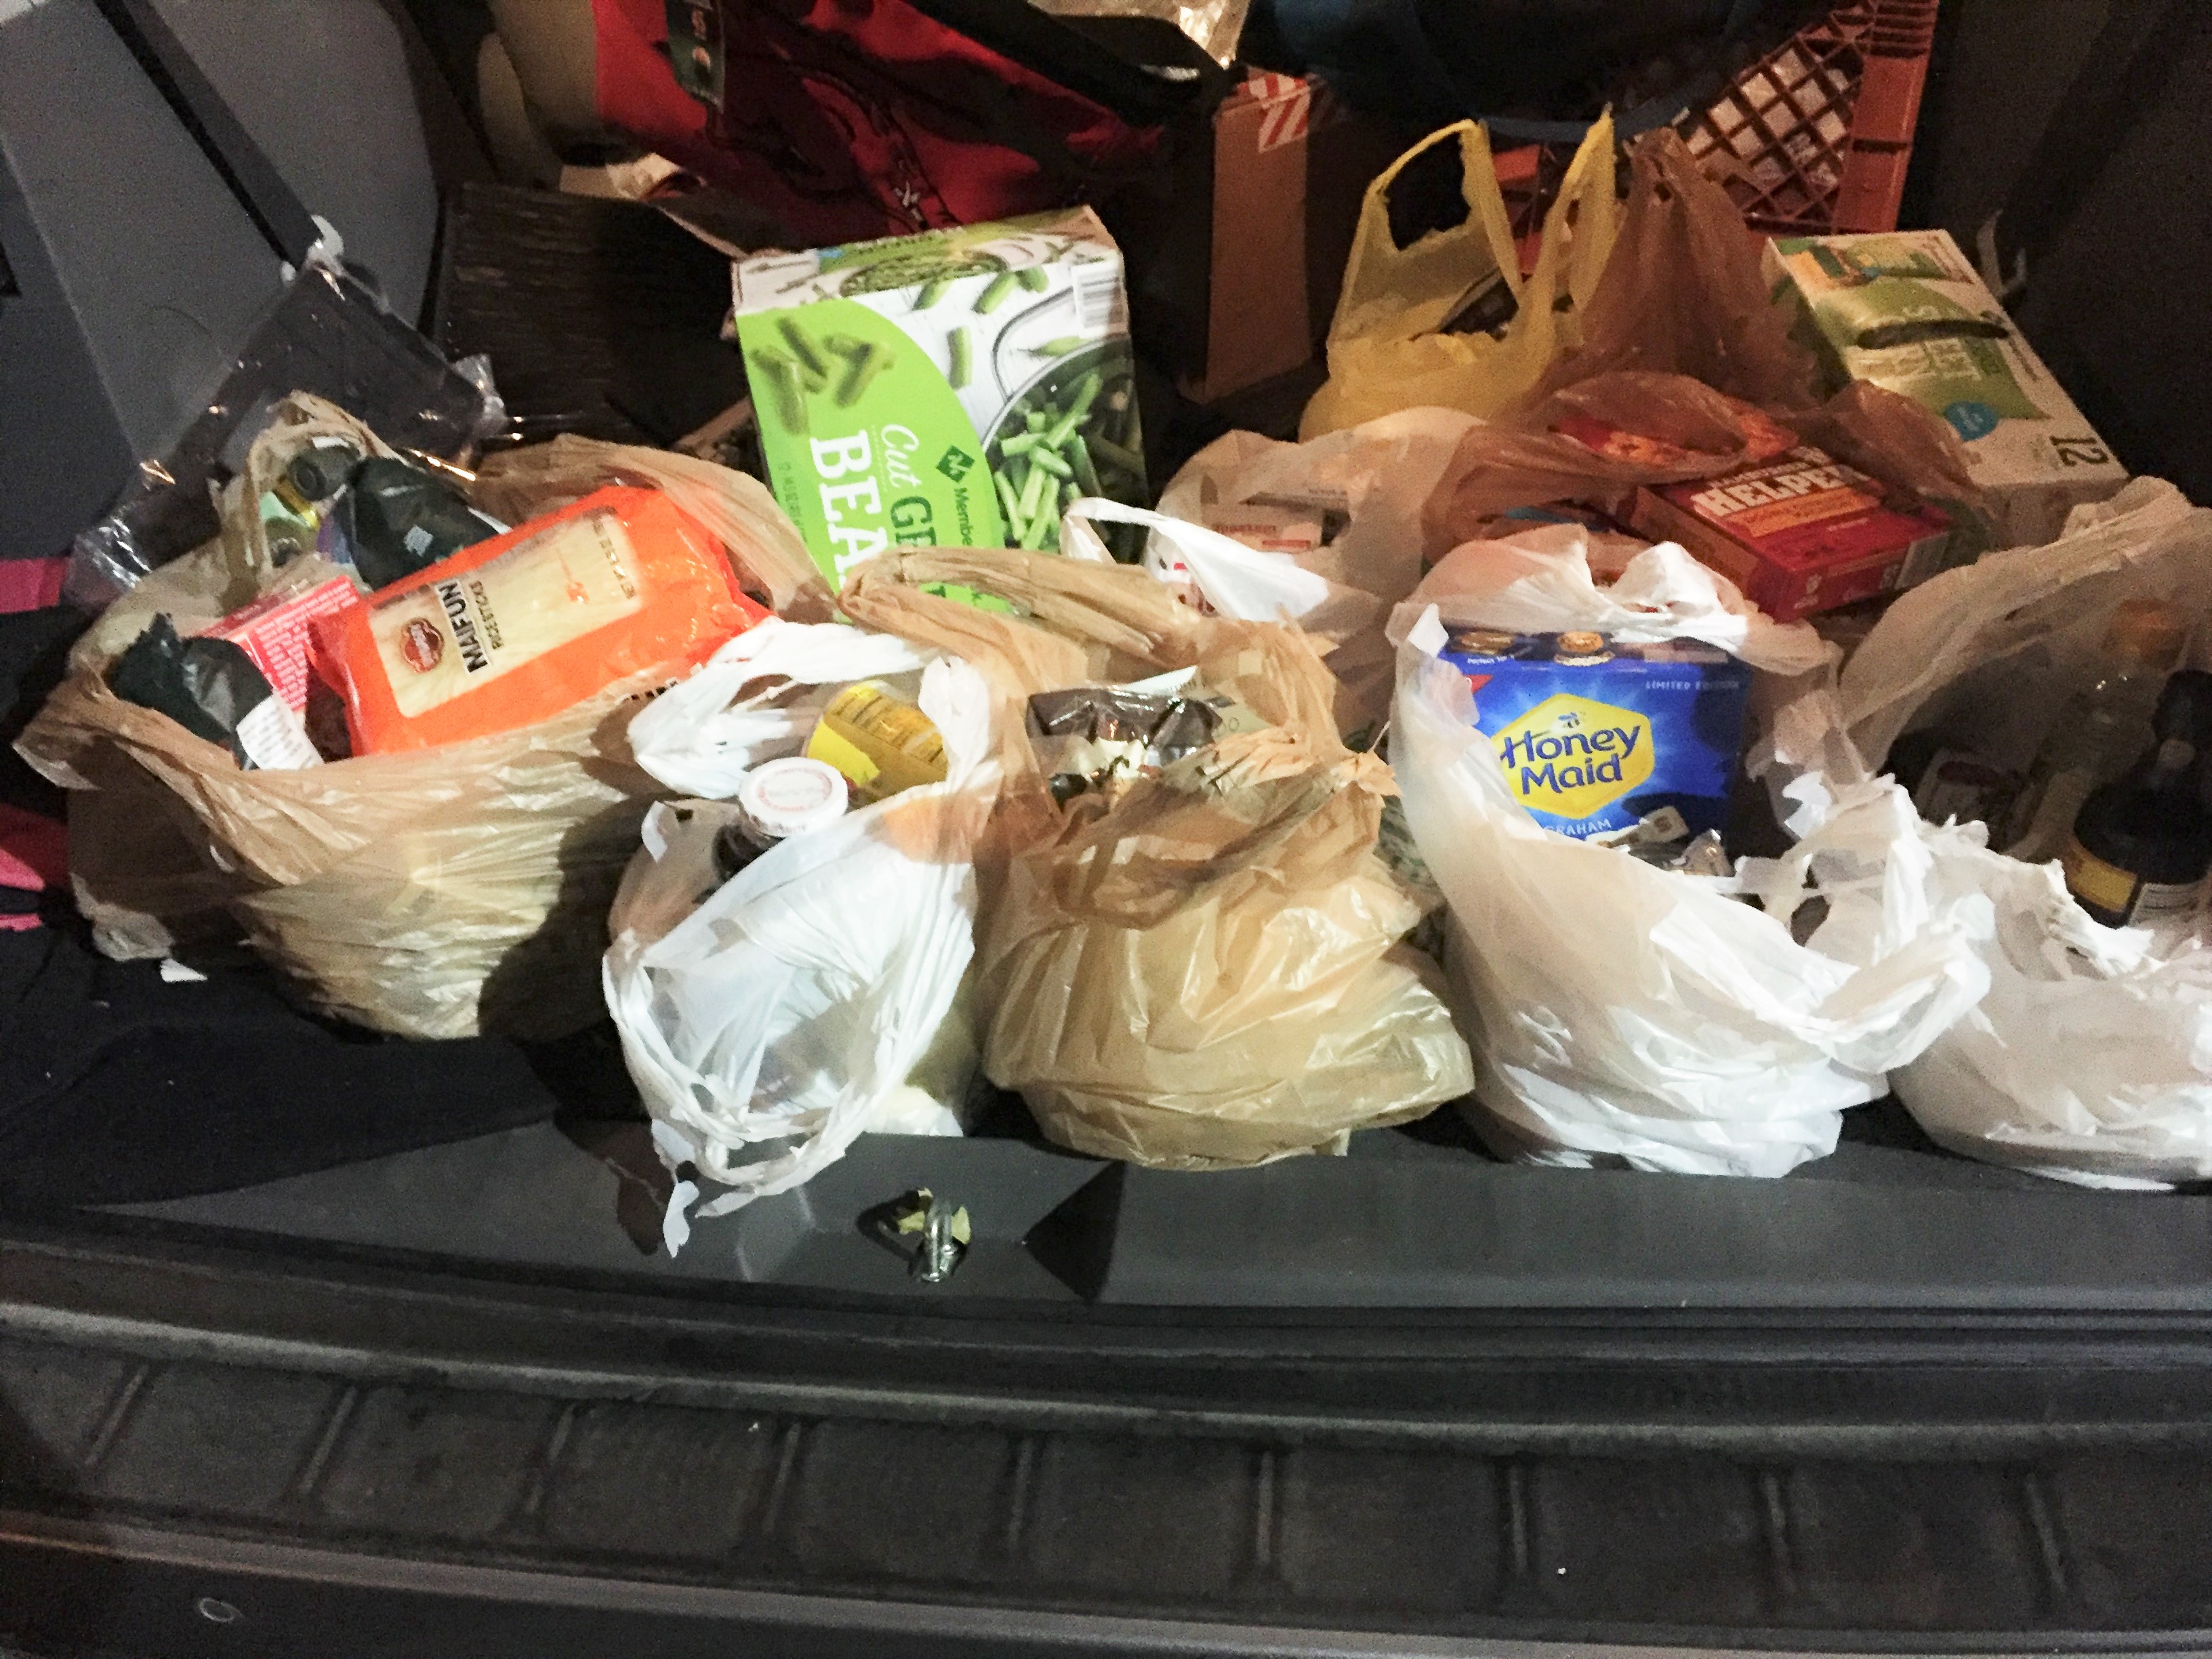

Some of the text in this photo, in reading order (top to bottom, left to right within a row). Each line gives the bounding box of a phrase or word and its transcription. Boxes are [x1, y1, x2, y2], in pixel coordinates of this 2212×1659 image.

[880, 424, 922, 488] Cut
[2049, 435, 2109, 467] 12
[809, 430, 888, 589] BEA
[954, 487, 973, 546] Membe
[438, 580, 489, 673] MAIFUN
[1500, 724, 1641, 771] Honey
[1521, 755, 1623, 795] Maid
